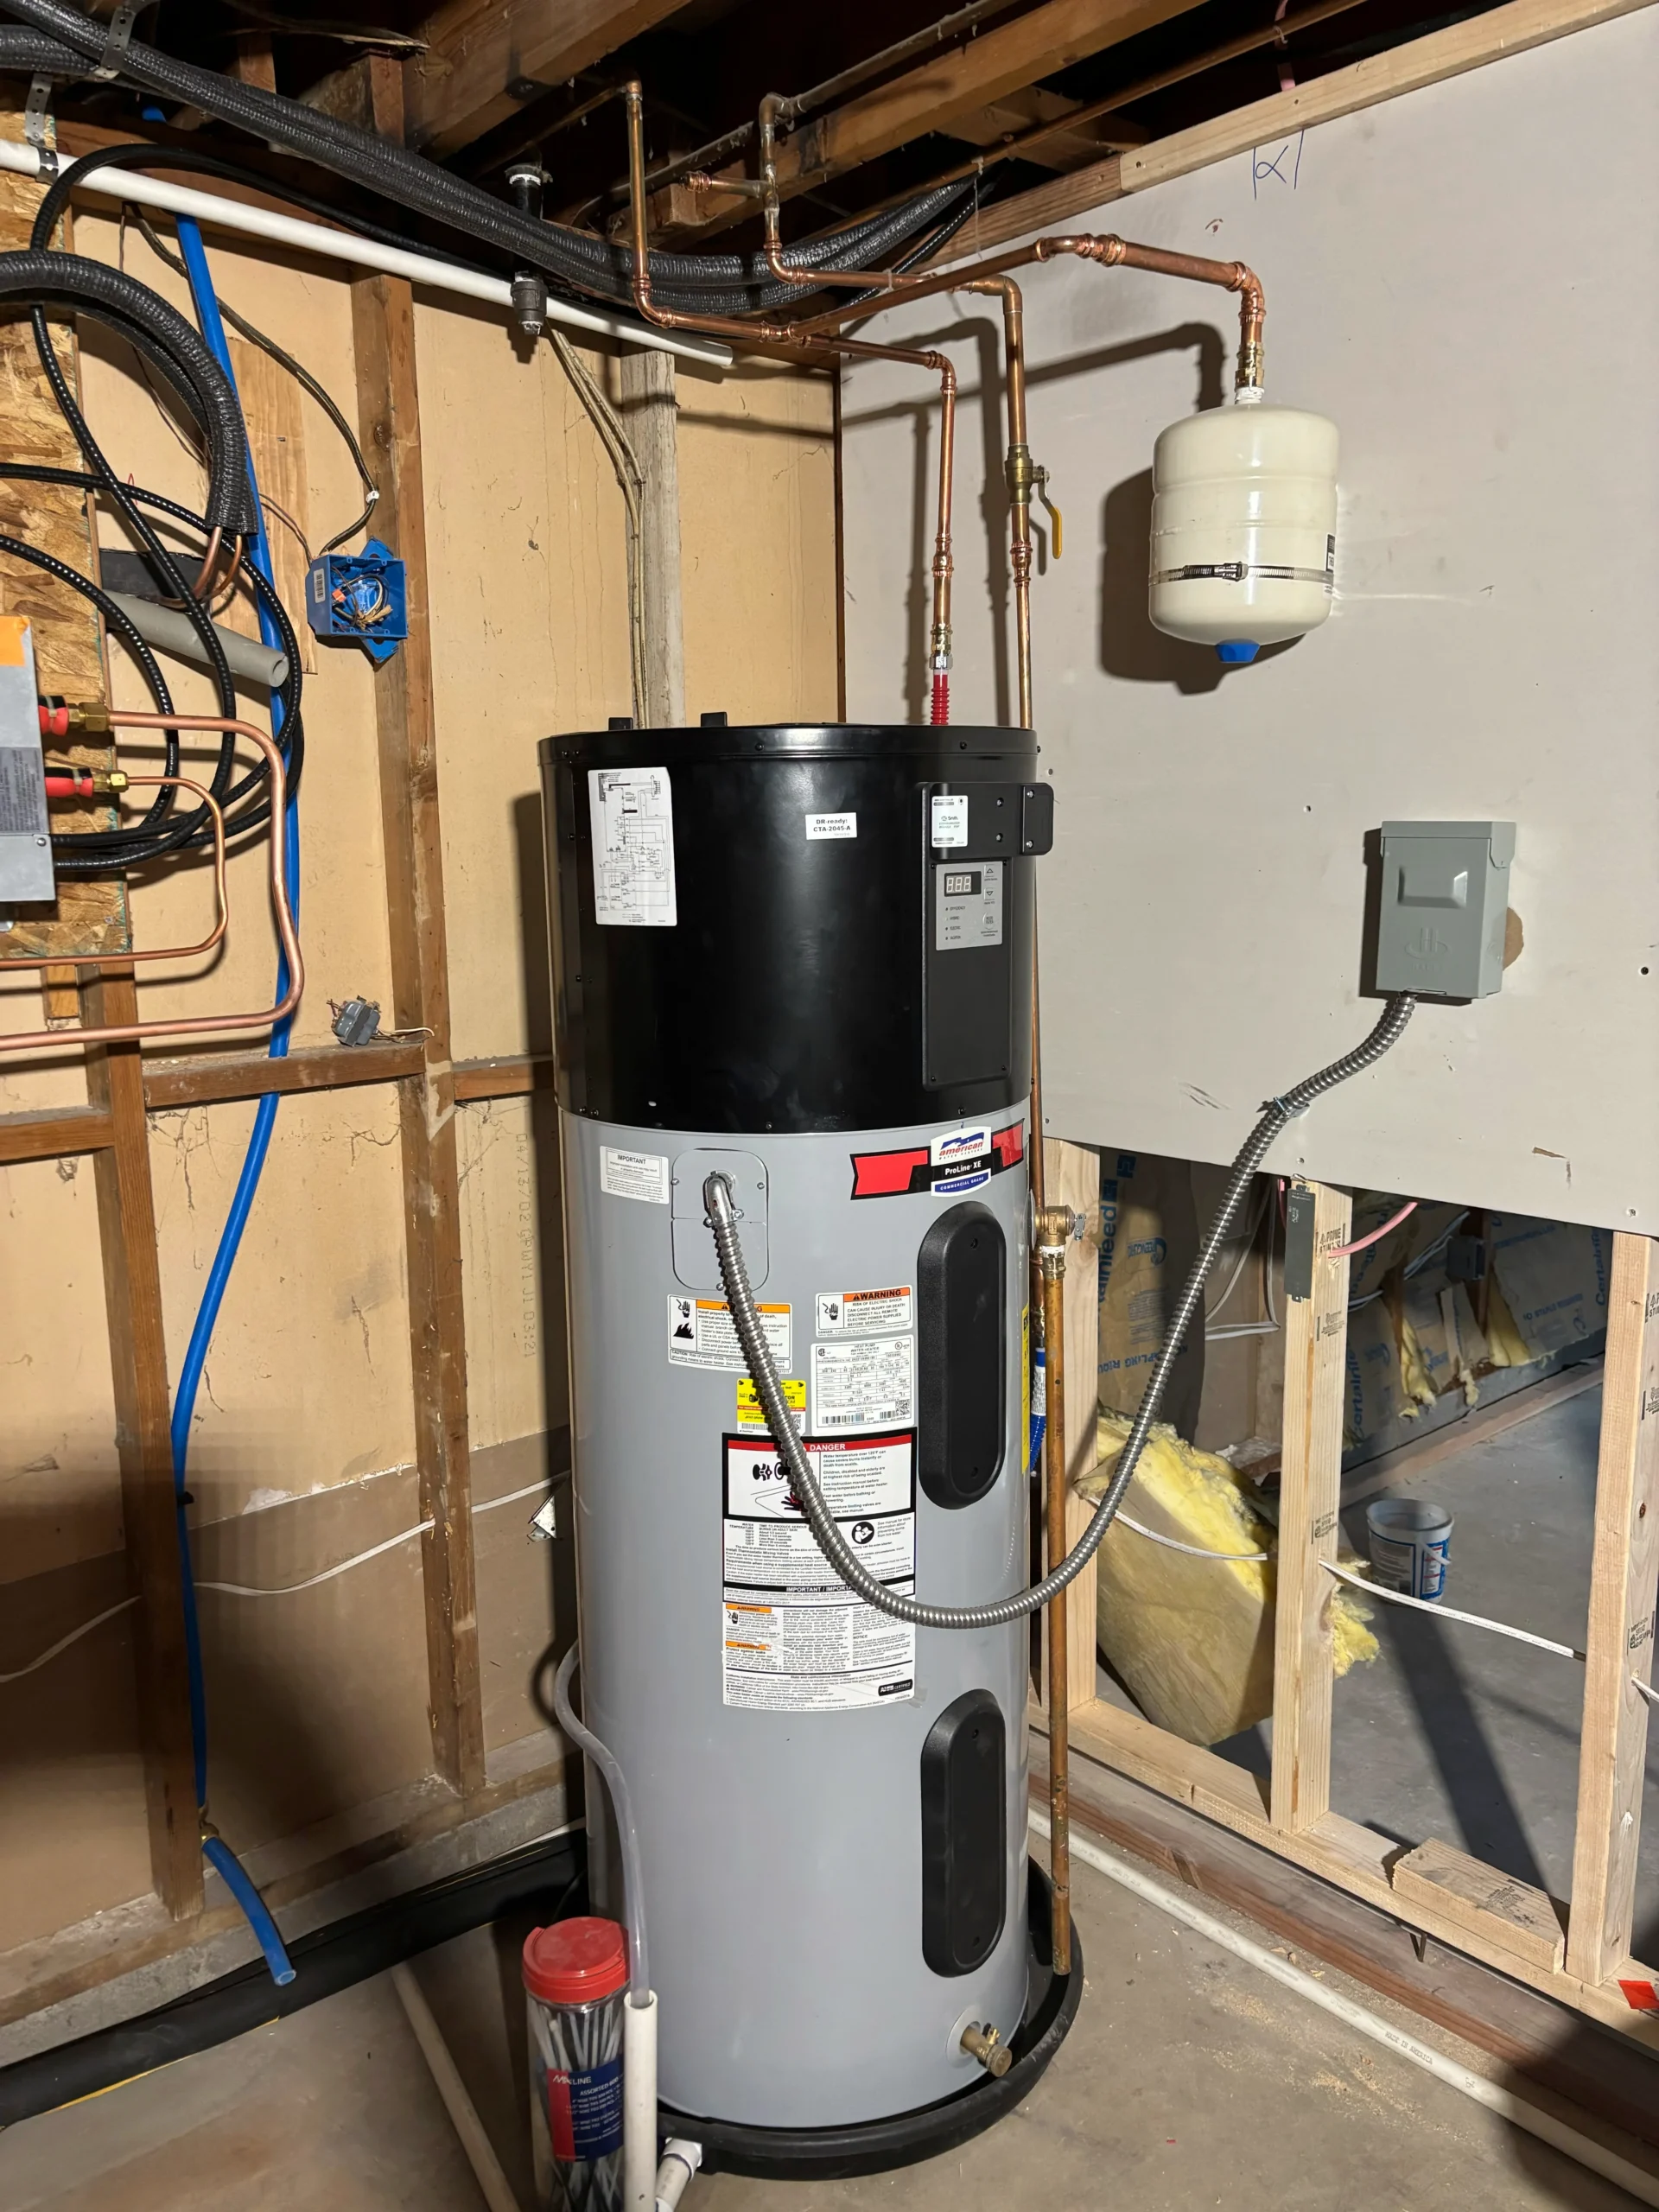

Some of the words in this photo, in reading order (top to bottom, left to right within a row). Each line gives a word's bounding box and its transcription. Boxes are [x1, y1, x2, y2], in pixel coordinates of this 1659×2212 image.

[939, 1141, 983, 1156] american
[618, 1154, 646, 1164] IMPORTANT
[945, 1165, 970, 1175] ProLine
[973, 1160, 982, 1169] XE
[516, 1134, 531, 1222] 04/13/02
[940, 1181, 969, 1190] COMMERCIAL
[861, 1289, 901, 1300] WARNING
[523, 1311, 536, 1358] 03:21
[1409, 2046, 1433, 2064] AMERICA
[581, 2083, 609, 2096] ASSORTED
